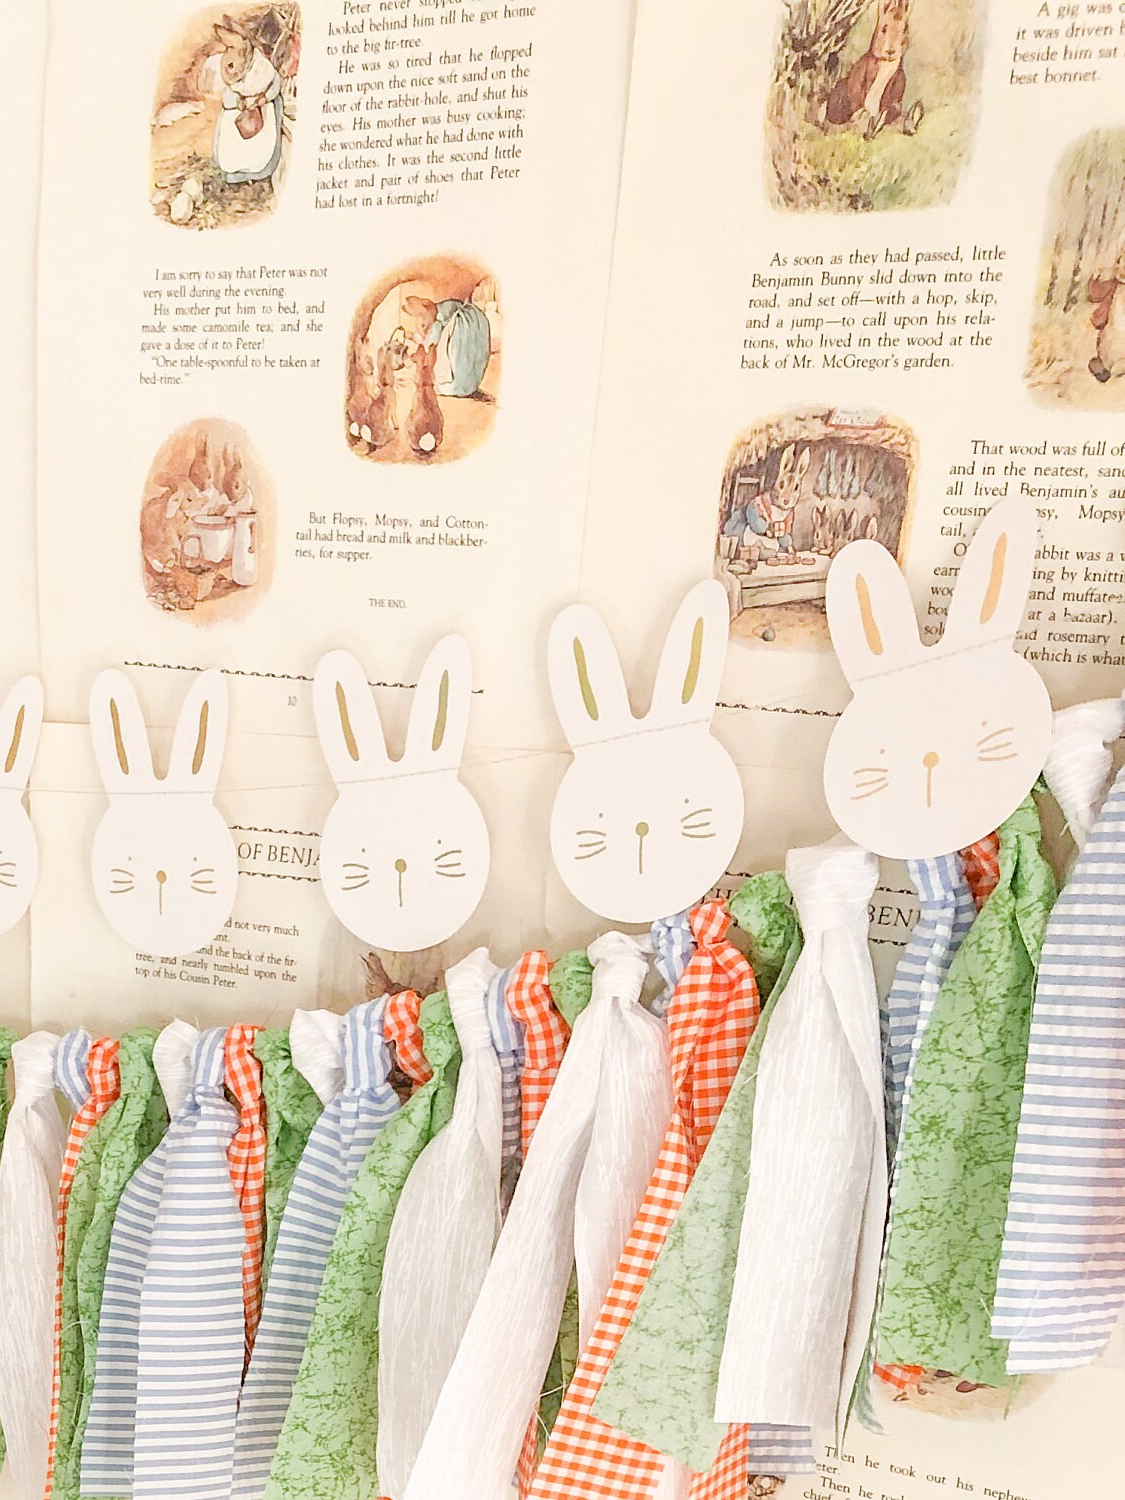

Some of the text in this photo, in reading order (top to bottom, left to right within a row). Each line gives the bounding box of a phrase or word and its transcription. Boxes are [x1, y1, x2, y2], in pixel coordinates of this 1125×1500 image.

[1036, 1, 1113, 19] A gig was
[328, 4, 536, 36] looked behind him till he got home
[1015, 21, 1113, 40] it was driven
[326, 45, 338, 56] to
[341, 39, 359, 54] the
[363, 37, 380, 54] big
[1012, 44, 1117, 63] beside him sat
[338, 42, 532, 74] He was so tired that he flopped
[1009, 66, 1102, 85] best bonnet.
[769, 244, 1006, 267] As soon as they had passed, little
[155, 265, 327, 281] I am sorry to say that Peter was not
[751, 266, 1002, 290] Benjamin Bunny slid down into the
[142, 283, 286, 300] very well during the evening.
[970, 439, 1004, 455] That
[1009, 440, 1047, 455] wood
[1052, 445, 1077, 455] was
[1082, 440, 1106, 456] full
[949, 460, 1088, 478] and in the neatest,
[308, 511, 488, 529] But Flopsy, Mopsy, and Cotton-
[295, 527, 487, 547] tail had bread and milk and blackber-
[294, 545, 372, 562] ries, for supper.
[237, 841, 264, 860] OF
[135, 952, 297, 982] tree, and nearly tumbled upon the
[134, 966, 237, 988] top of his Cousin Peter.
[824, 1445, 855, 1463] Ten
[864, 1454, 880, 1469] he
[889, 1464, 916, 1477] took
[925, 1474, 946, 1484] out
[956, 1476, 973, 1491] his
[819, 1475, 850, 1494] Then
[858, 1485, 873, 1499] he
